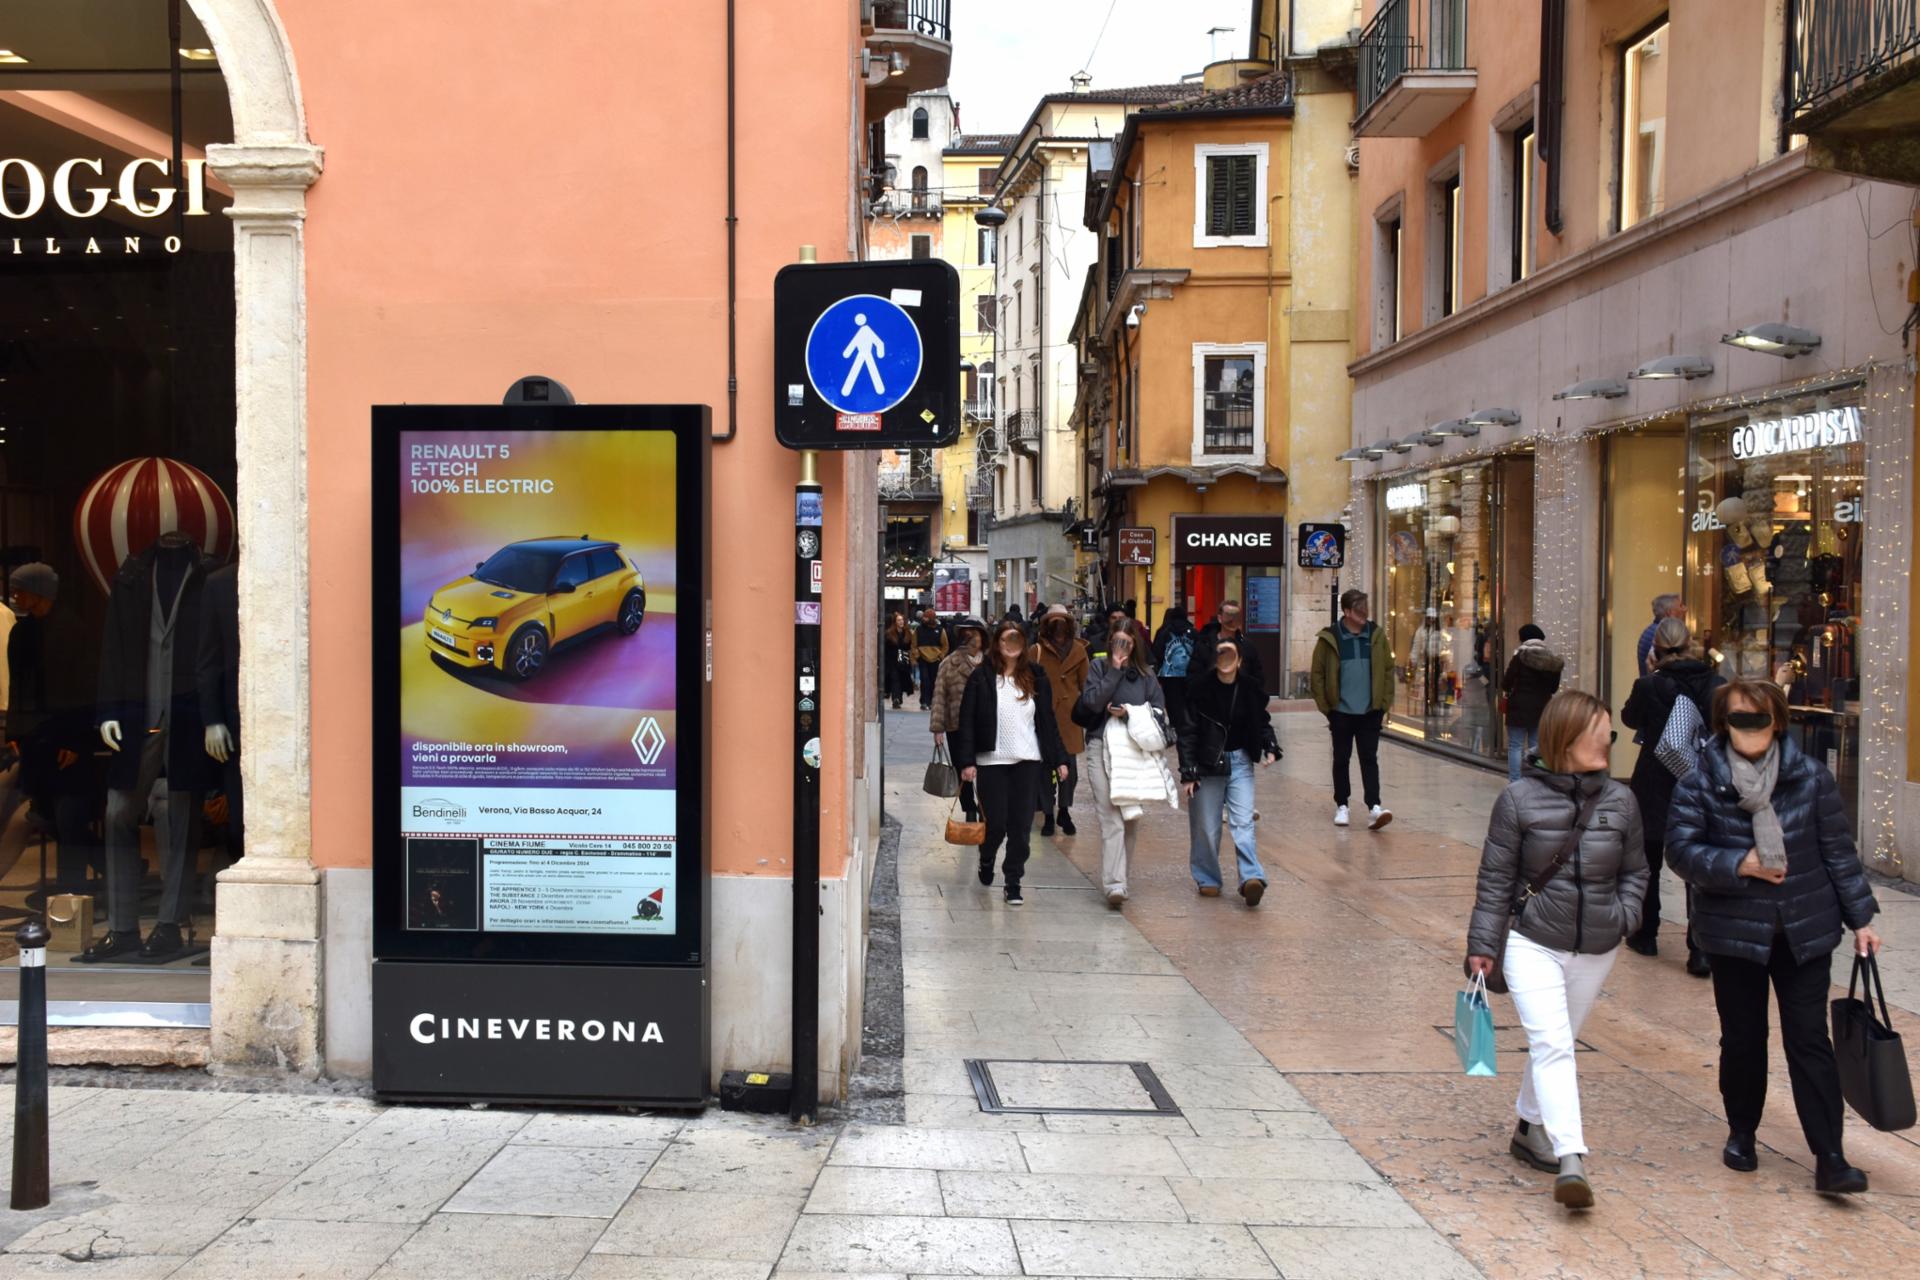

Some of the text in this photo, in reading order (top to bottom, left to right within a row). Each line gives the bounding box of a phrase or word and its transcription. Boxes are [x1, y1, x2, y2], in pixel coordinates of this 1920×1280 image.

[411, 445, 510, 459] RENAULT 5
[411, 462, 478, 477] E-TECH
[411, 480, 554, 495] 100% ELECTRIC
[1186, 533, 1272, 547] CHANGE
[412, 742, 568, 755] disponibile ora in showroom,
[412, 753, 497, 765] vieni a provarla
[413, 805, 467, 819] Bendinelli
[478, 806, 602, 817] Verona, Via Basso Acquar, 24
[489, 840, 520, 848] CINEMA
[521, 840, 546, 848] FIUME
